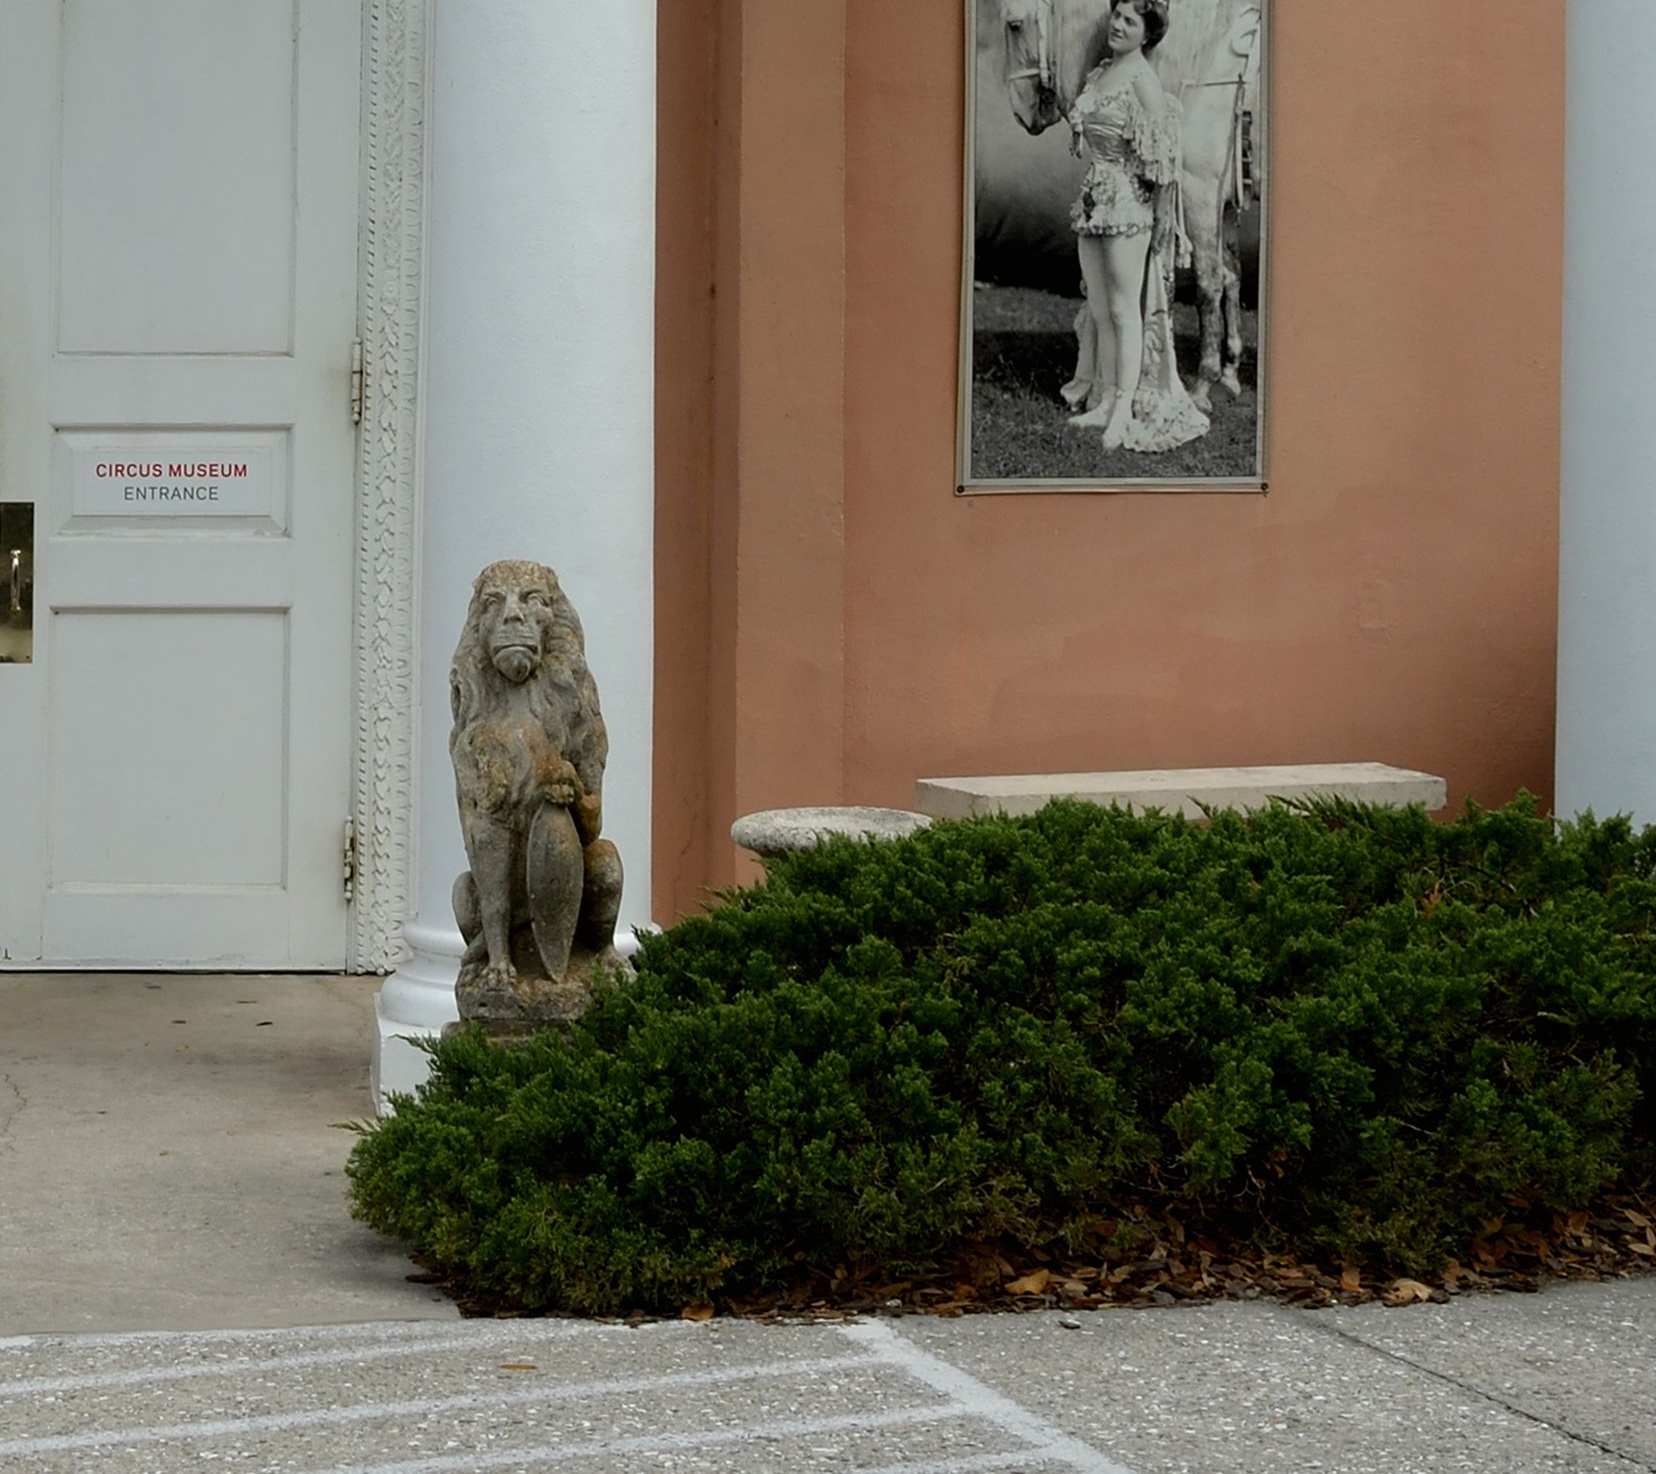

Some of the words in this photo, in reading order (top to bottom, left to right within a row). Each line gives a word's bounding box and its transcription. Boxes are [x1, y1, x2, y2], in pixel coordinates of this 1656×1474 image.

[95, 463, 163, 478] CIRCUS
[168, 463, 248, 478] MUSEUM
[124, 486, 219, 501] ENTRANCE
